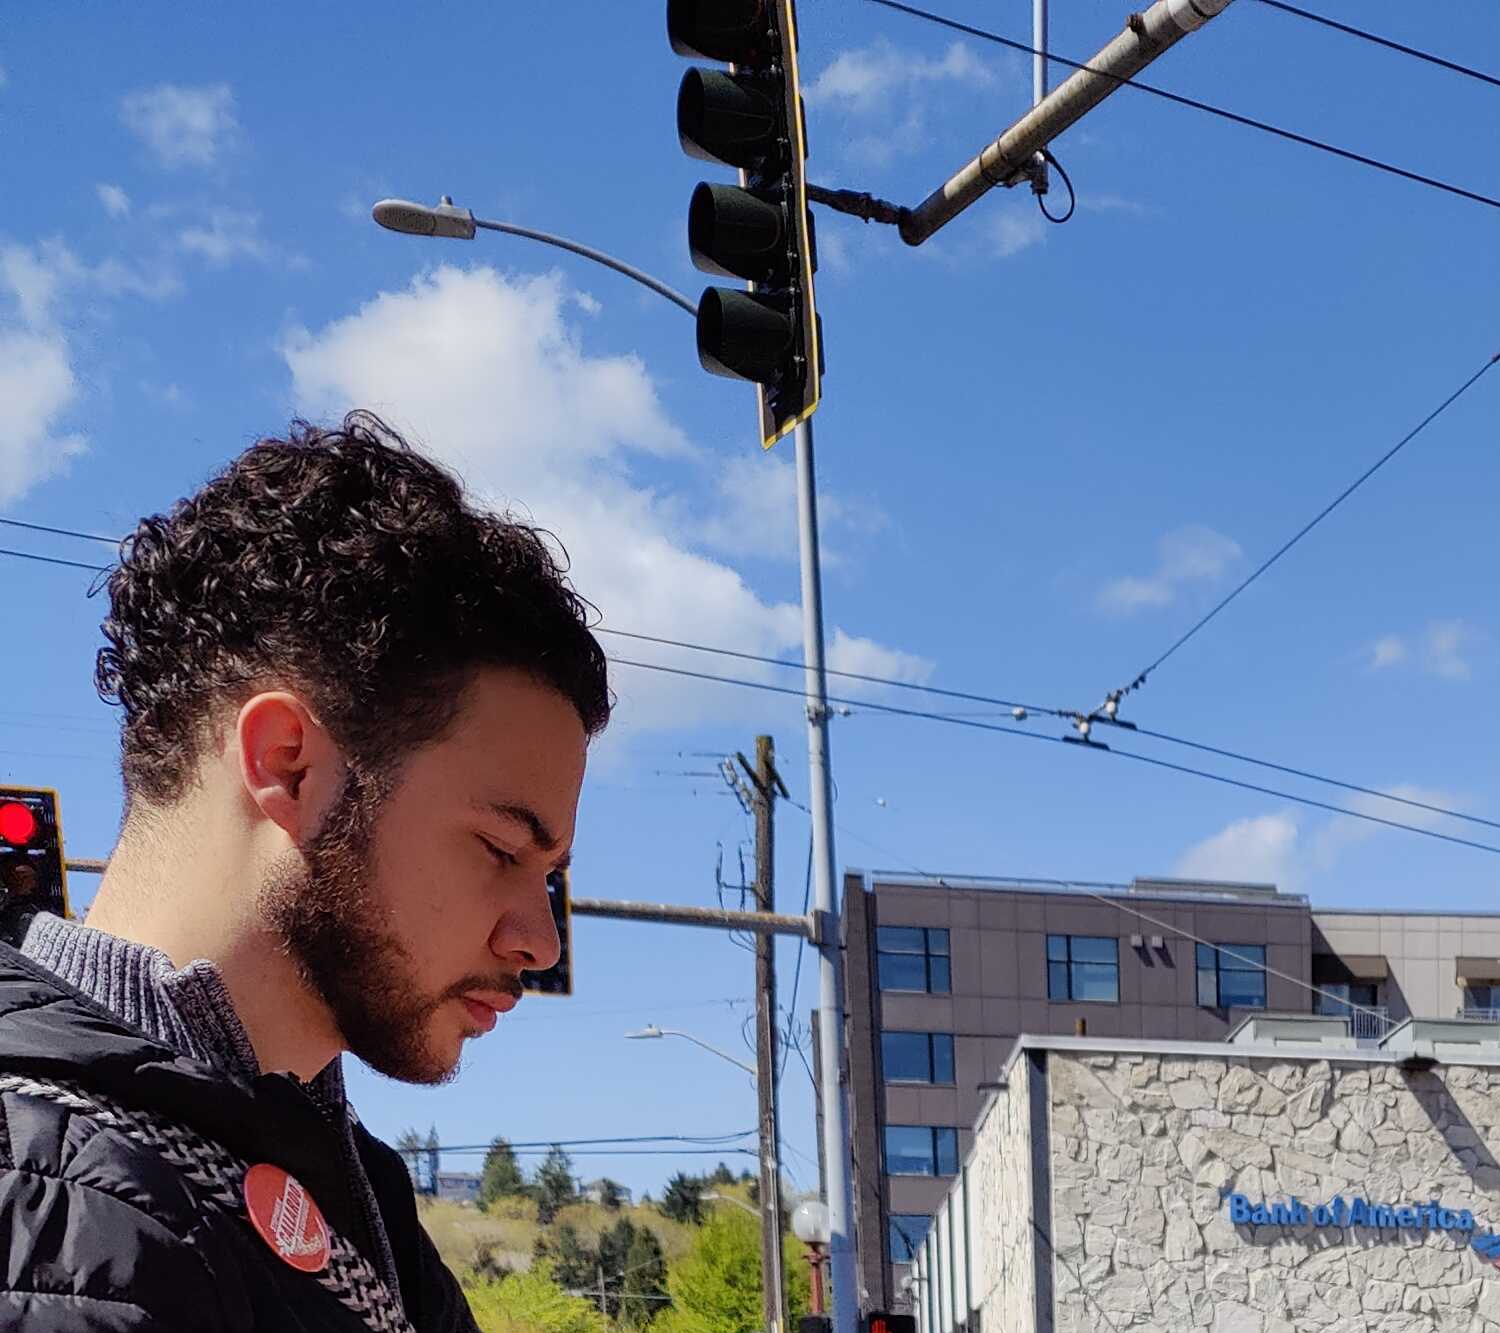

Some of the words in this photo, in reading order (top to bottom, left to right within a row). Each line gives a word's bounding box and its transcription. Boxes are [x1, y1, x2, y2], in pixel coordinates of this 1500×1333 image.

[1230, 1193, 1307, 1227] Bank
[1313, 1194, 1344, 1227] of
[1347, 1199, 1474, 1231] America
